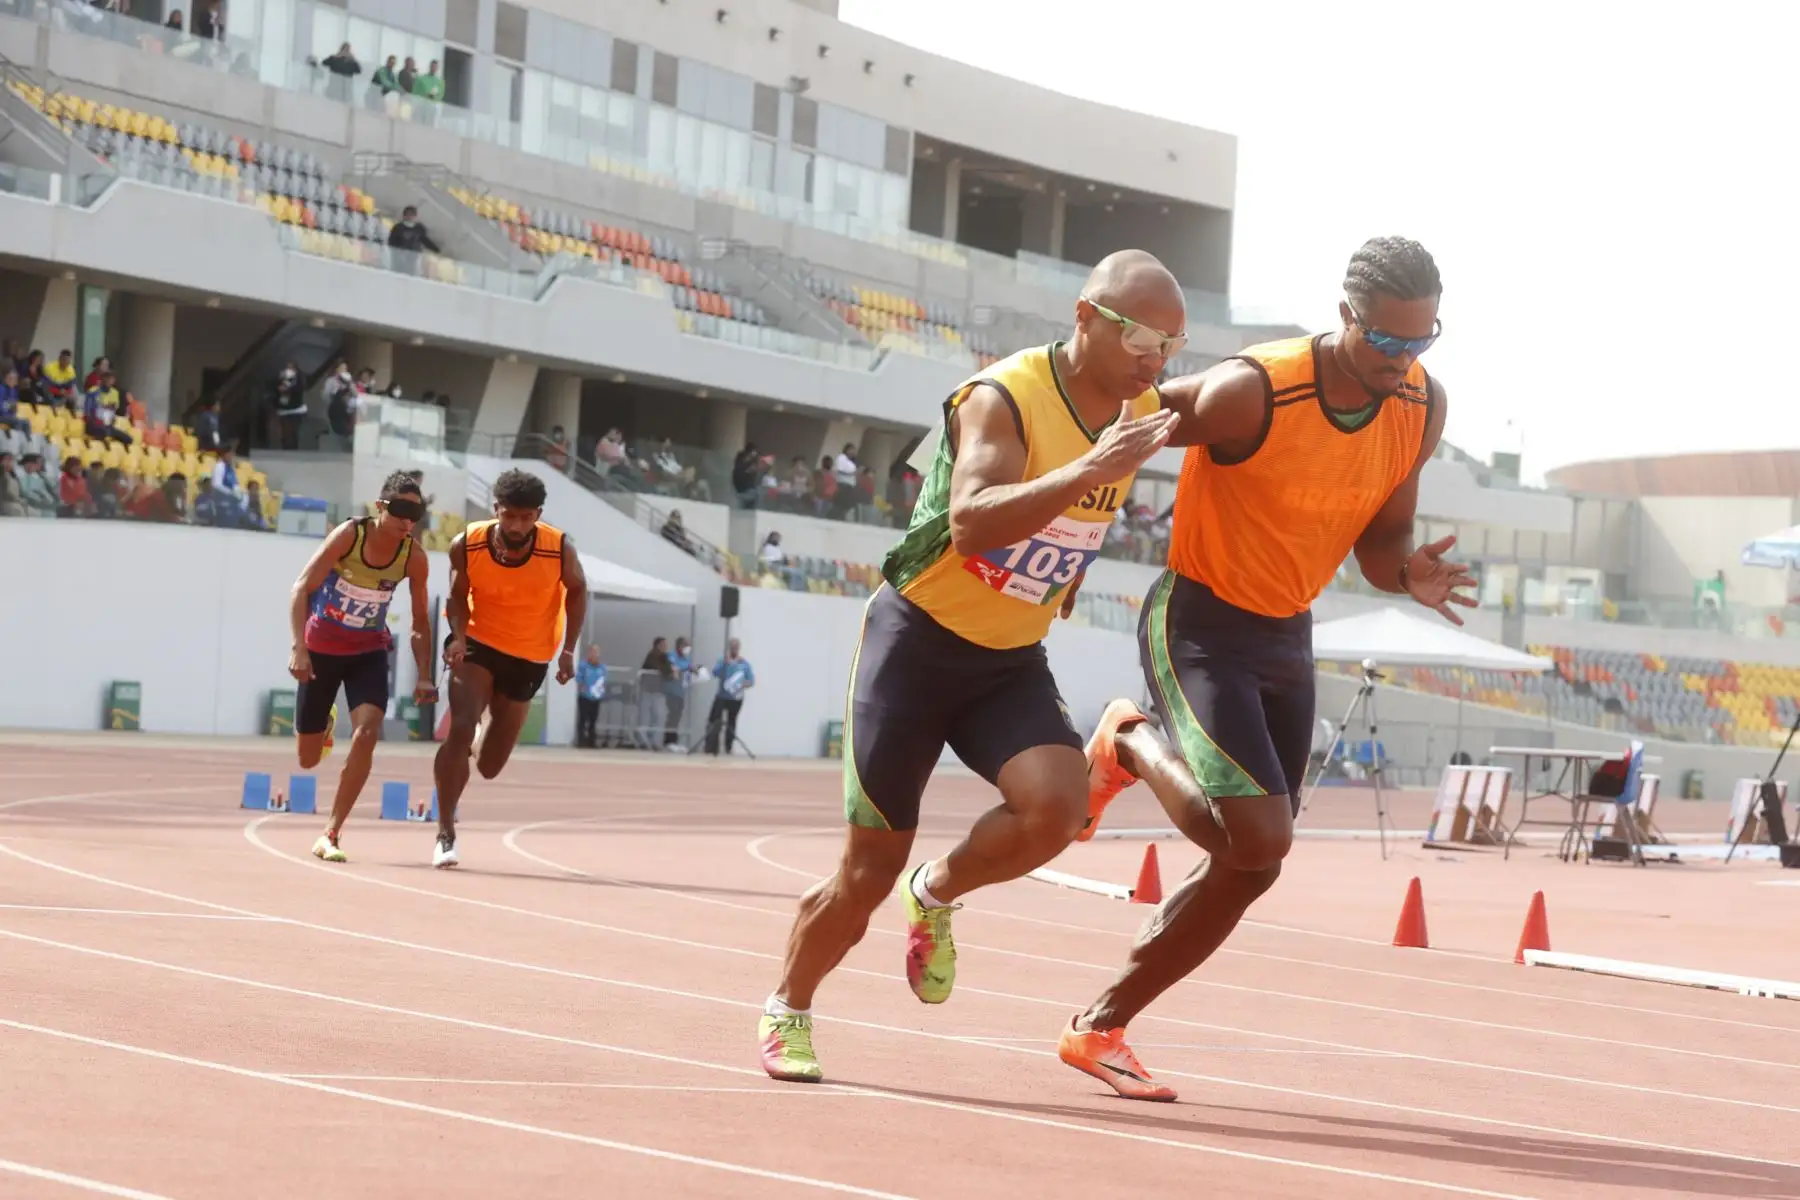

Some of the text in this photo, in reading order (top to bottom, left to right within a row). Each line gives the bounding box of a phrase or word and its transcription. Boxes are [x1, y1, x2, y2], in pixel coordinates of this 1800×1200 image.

[1074, 484, 1117, 512] SIL
[1004, 539, 1084, 584] 103
[339, 597, 381, 618] 173
